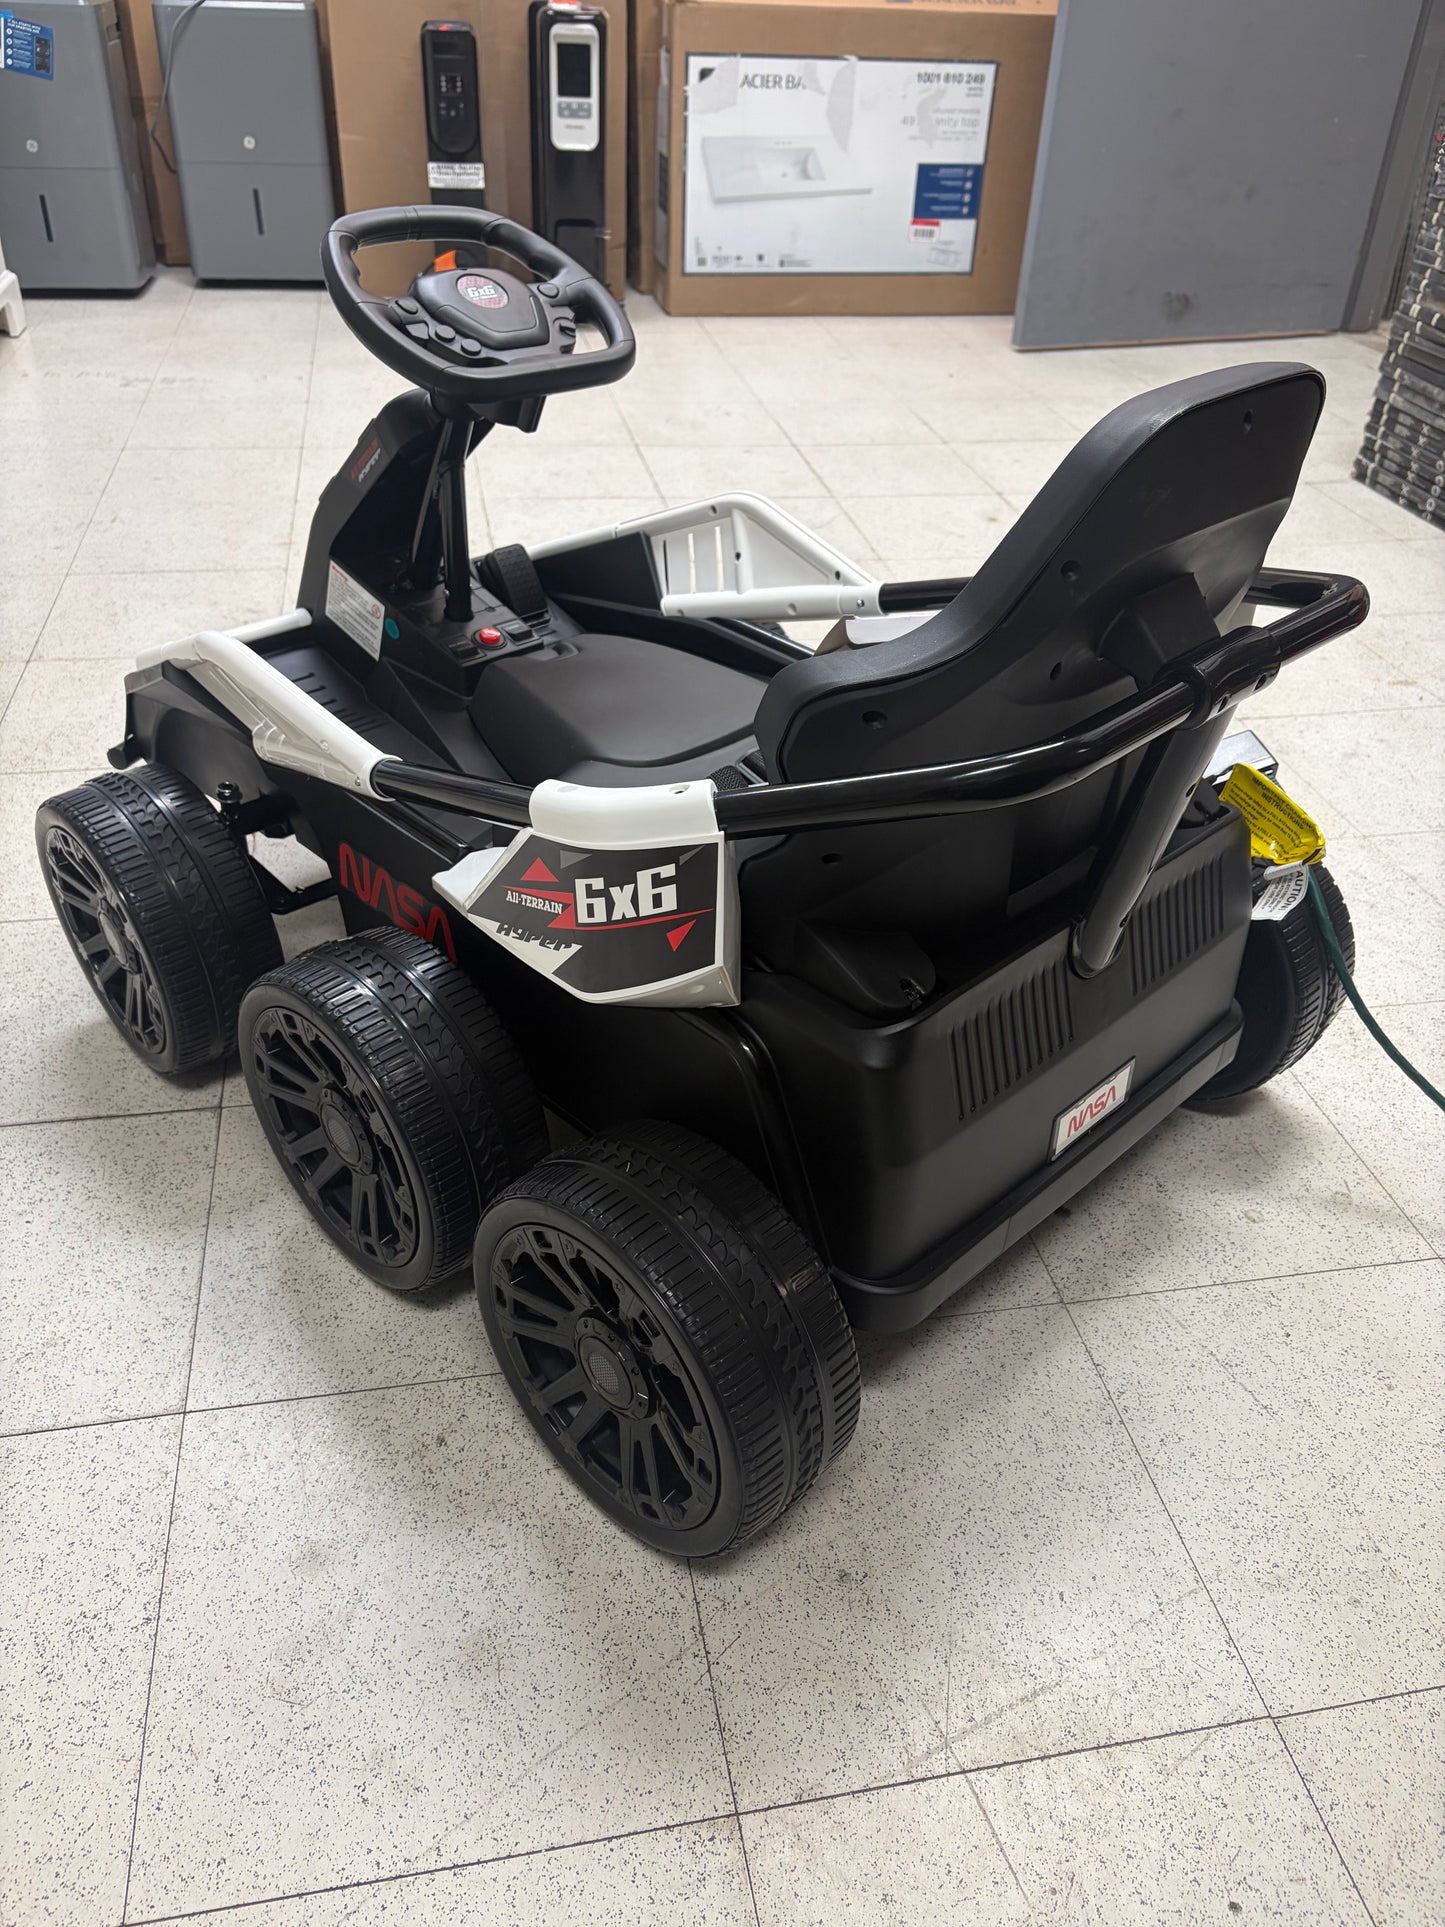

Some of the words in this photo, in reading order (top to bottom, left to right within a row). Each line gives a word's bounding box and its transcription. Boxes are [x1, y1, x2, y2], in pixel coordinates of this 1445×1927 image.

[740, 73, 783, 89] ACIER
[467, 285, 495, 297] 6x6
[1261, 792, 1304, 829] INSTRUCTIONS
[340, 842, 457, 967] NASA
[506, 890, 563, 915] All-TERRAIN
[574, 863, 678, 924] 6x6
[1278, 871, 1303, 910] AUTION!
[1066, 1085, 1117, 1138] NASA
